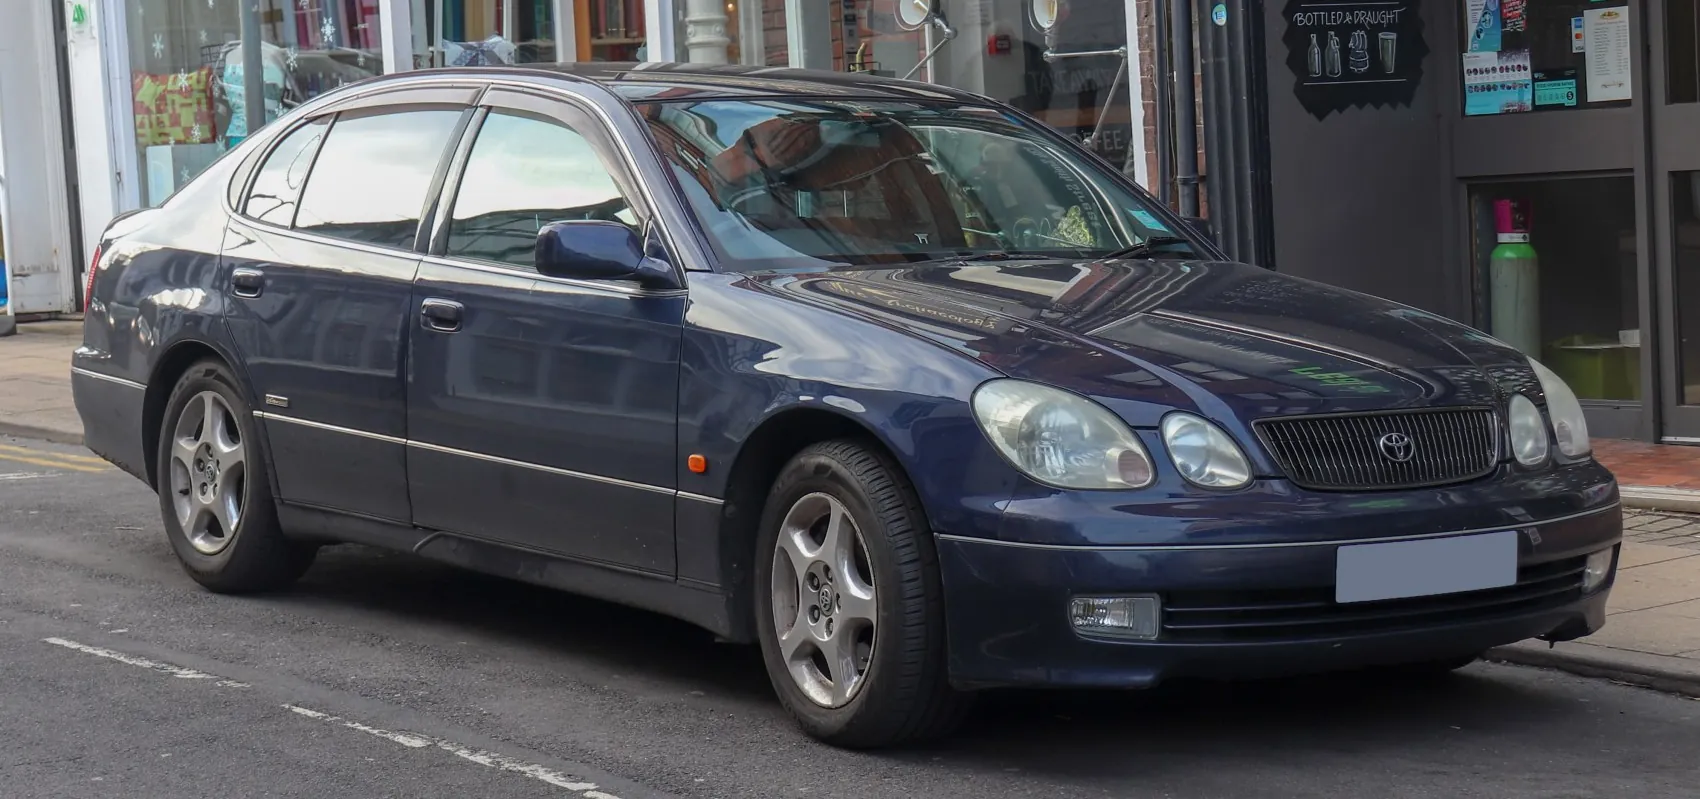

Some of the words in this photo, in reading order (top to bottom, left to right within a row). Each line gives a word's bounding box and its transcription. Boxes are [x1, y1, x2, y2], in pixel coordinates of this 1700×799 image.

[1293, 12, 1343, 25] BOTTLED
[1343, 12, 1352, 24] &
[1353, 7, 1407, 30] DRAUGHT
